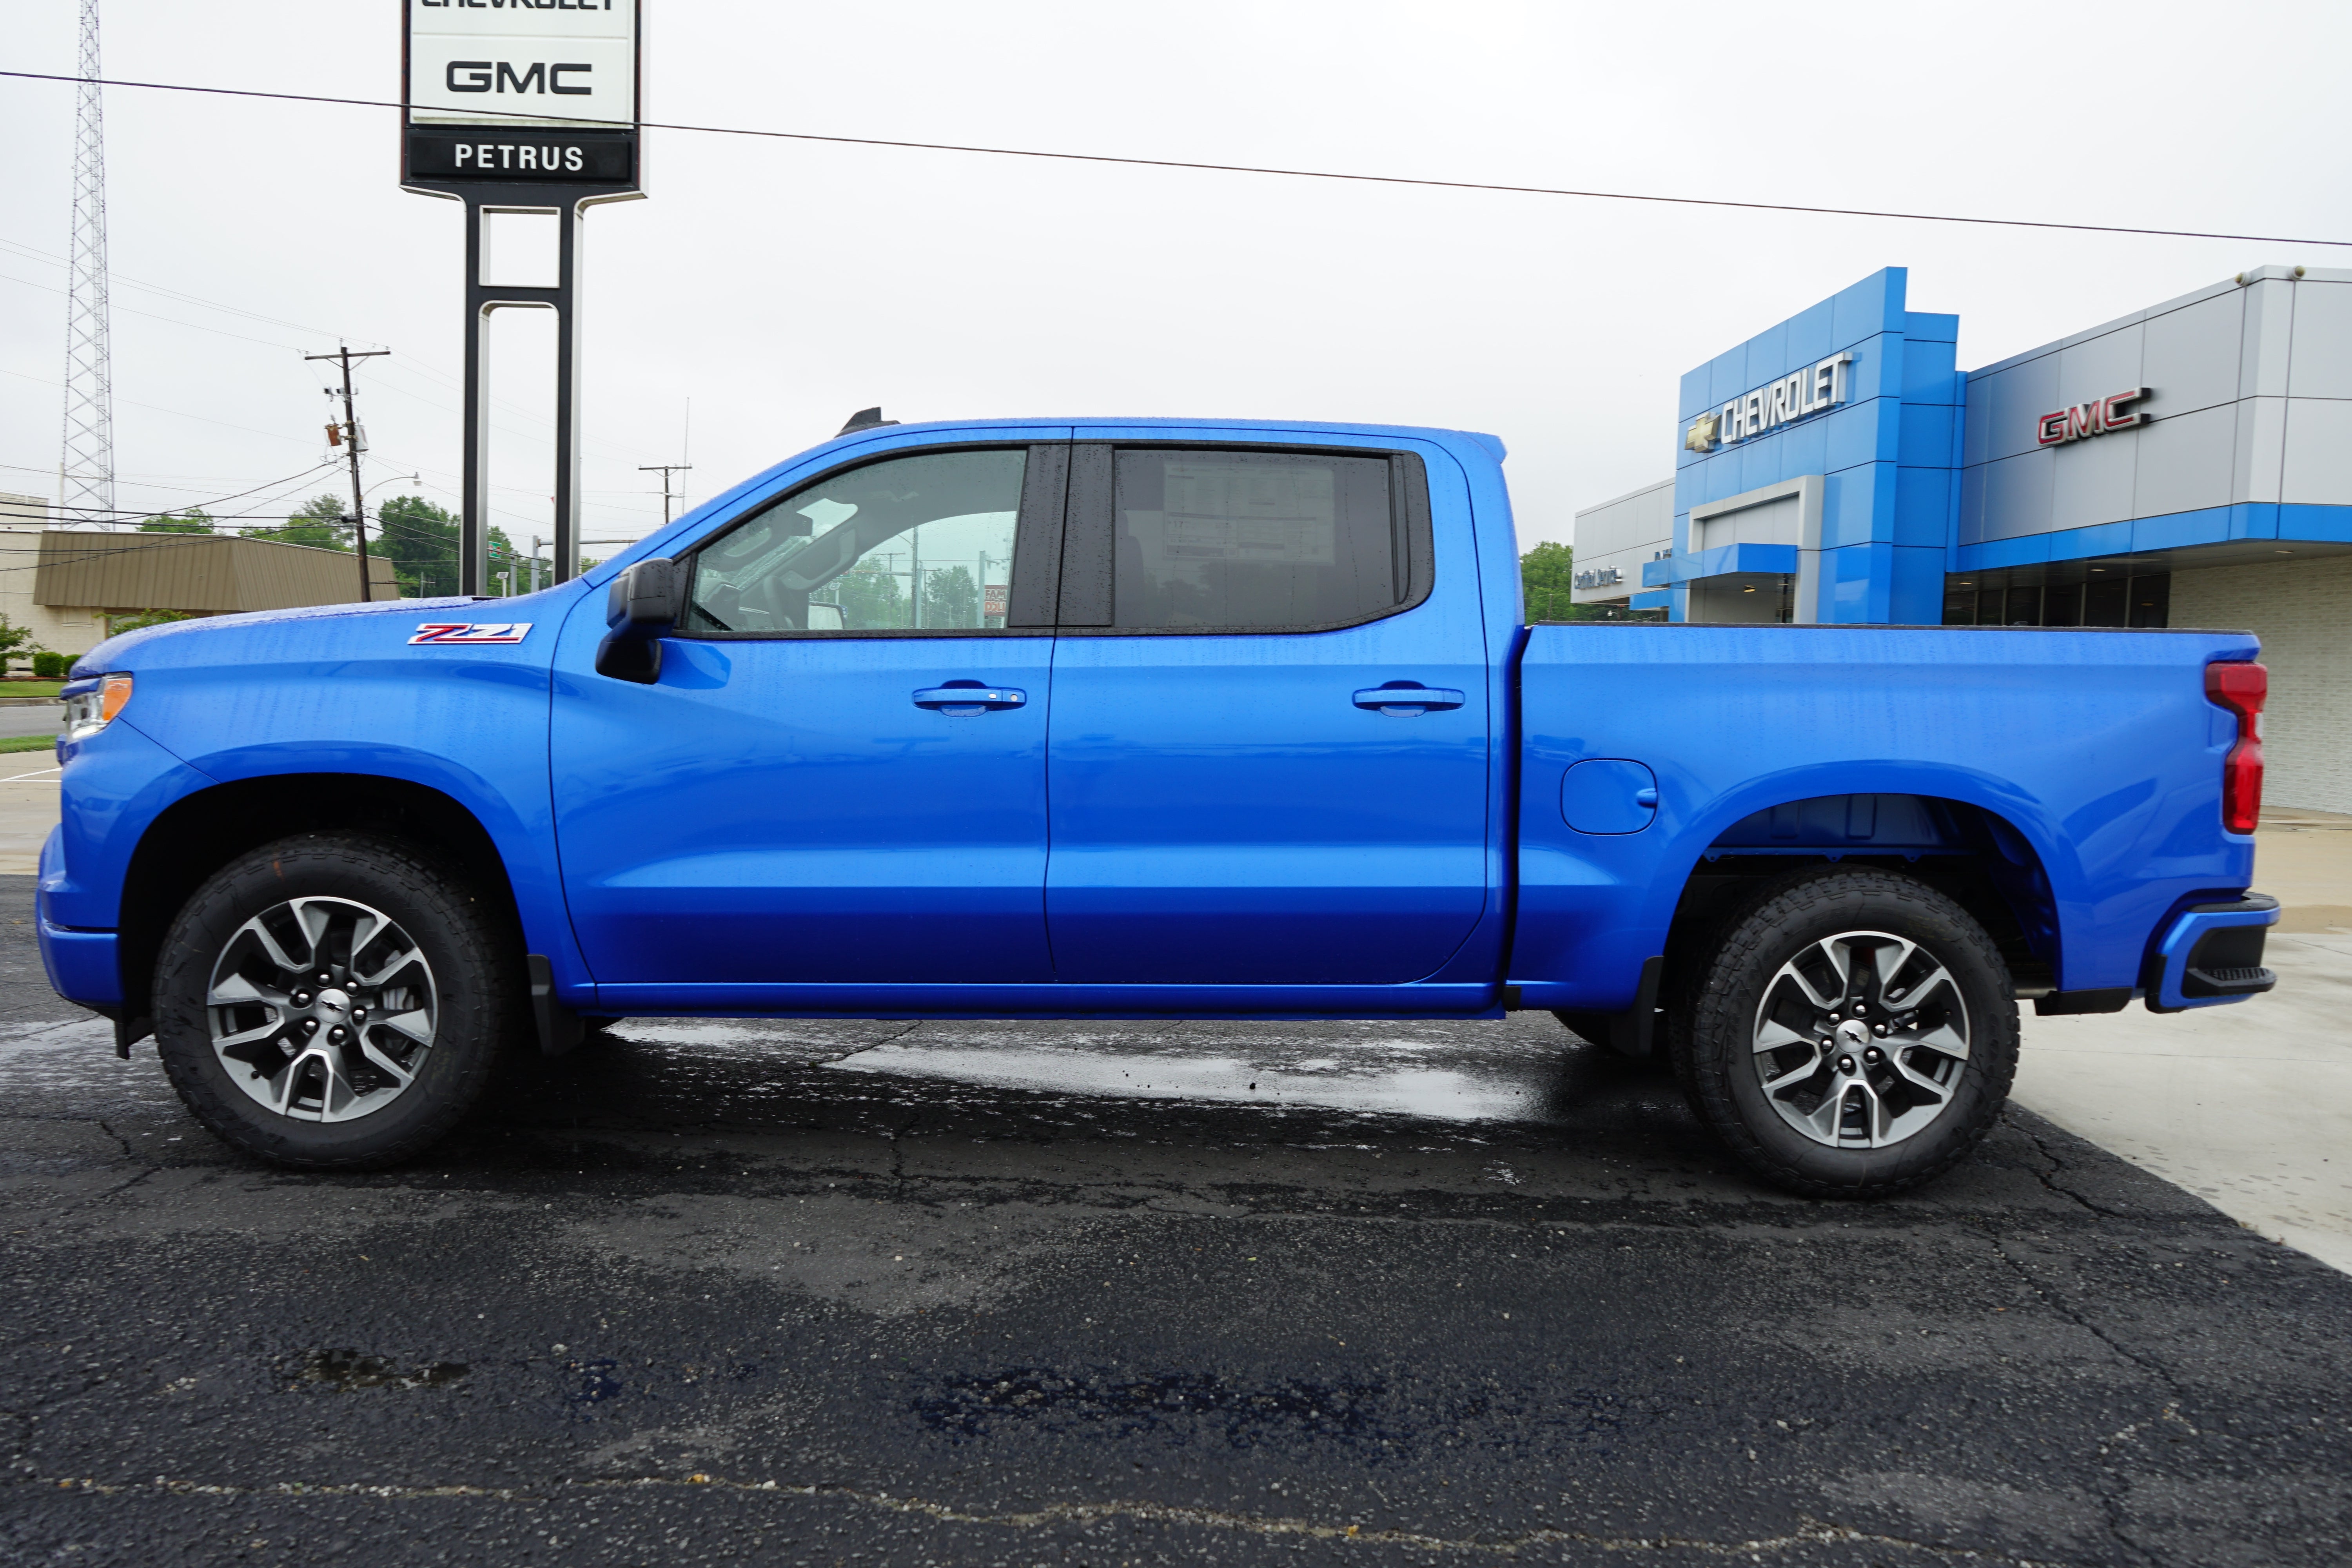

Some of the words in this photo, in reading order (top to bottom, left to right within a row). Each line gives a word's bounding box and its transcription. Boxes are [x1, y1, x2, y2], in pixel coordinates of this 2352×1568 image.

[446, 60, 592, 95] GMC
[455, 143, 584, 171] PETRUS
[1720, 352, 1853, 444] CHEVROLET
[2037, 387, 2151, 448] GMC
[407, 623, 534, 646] Z71
